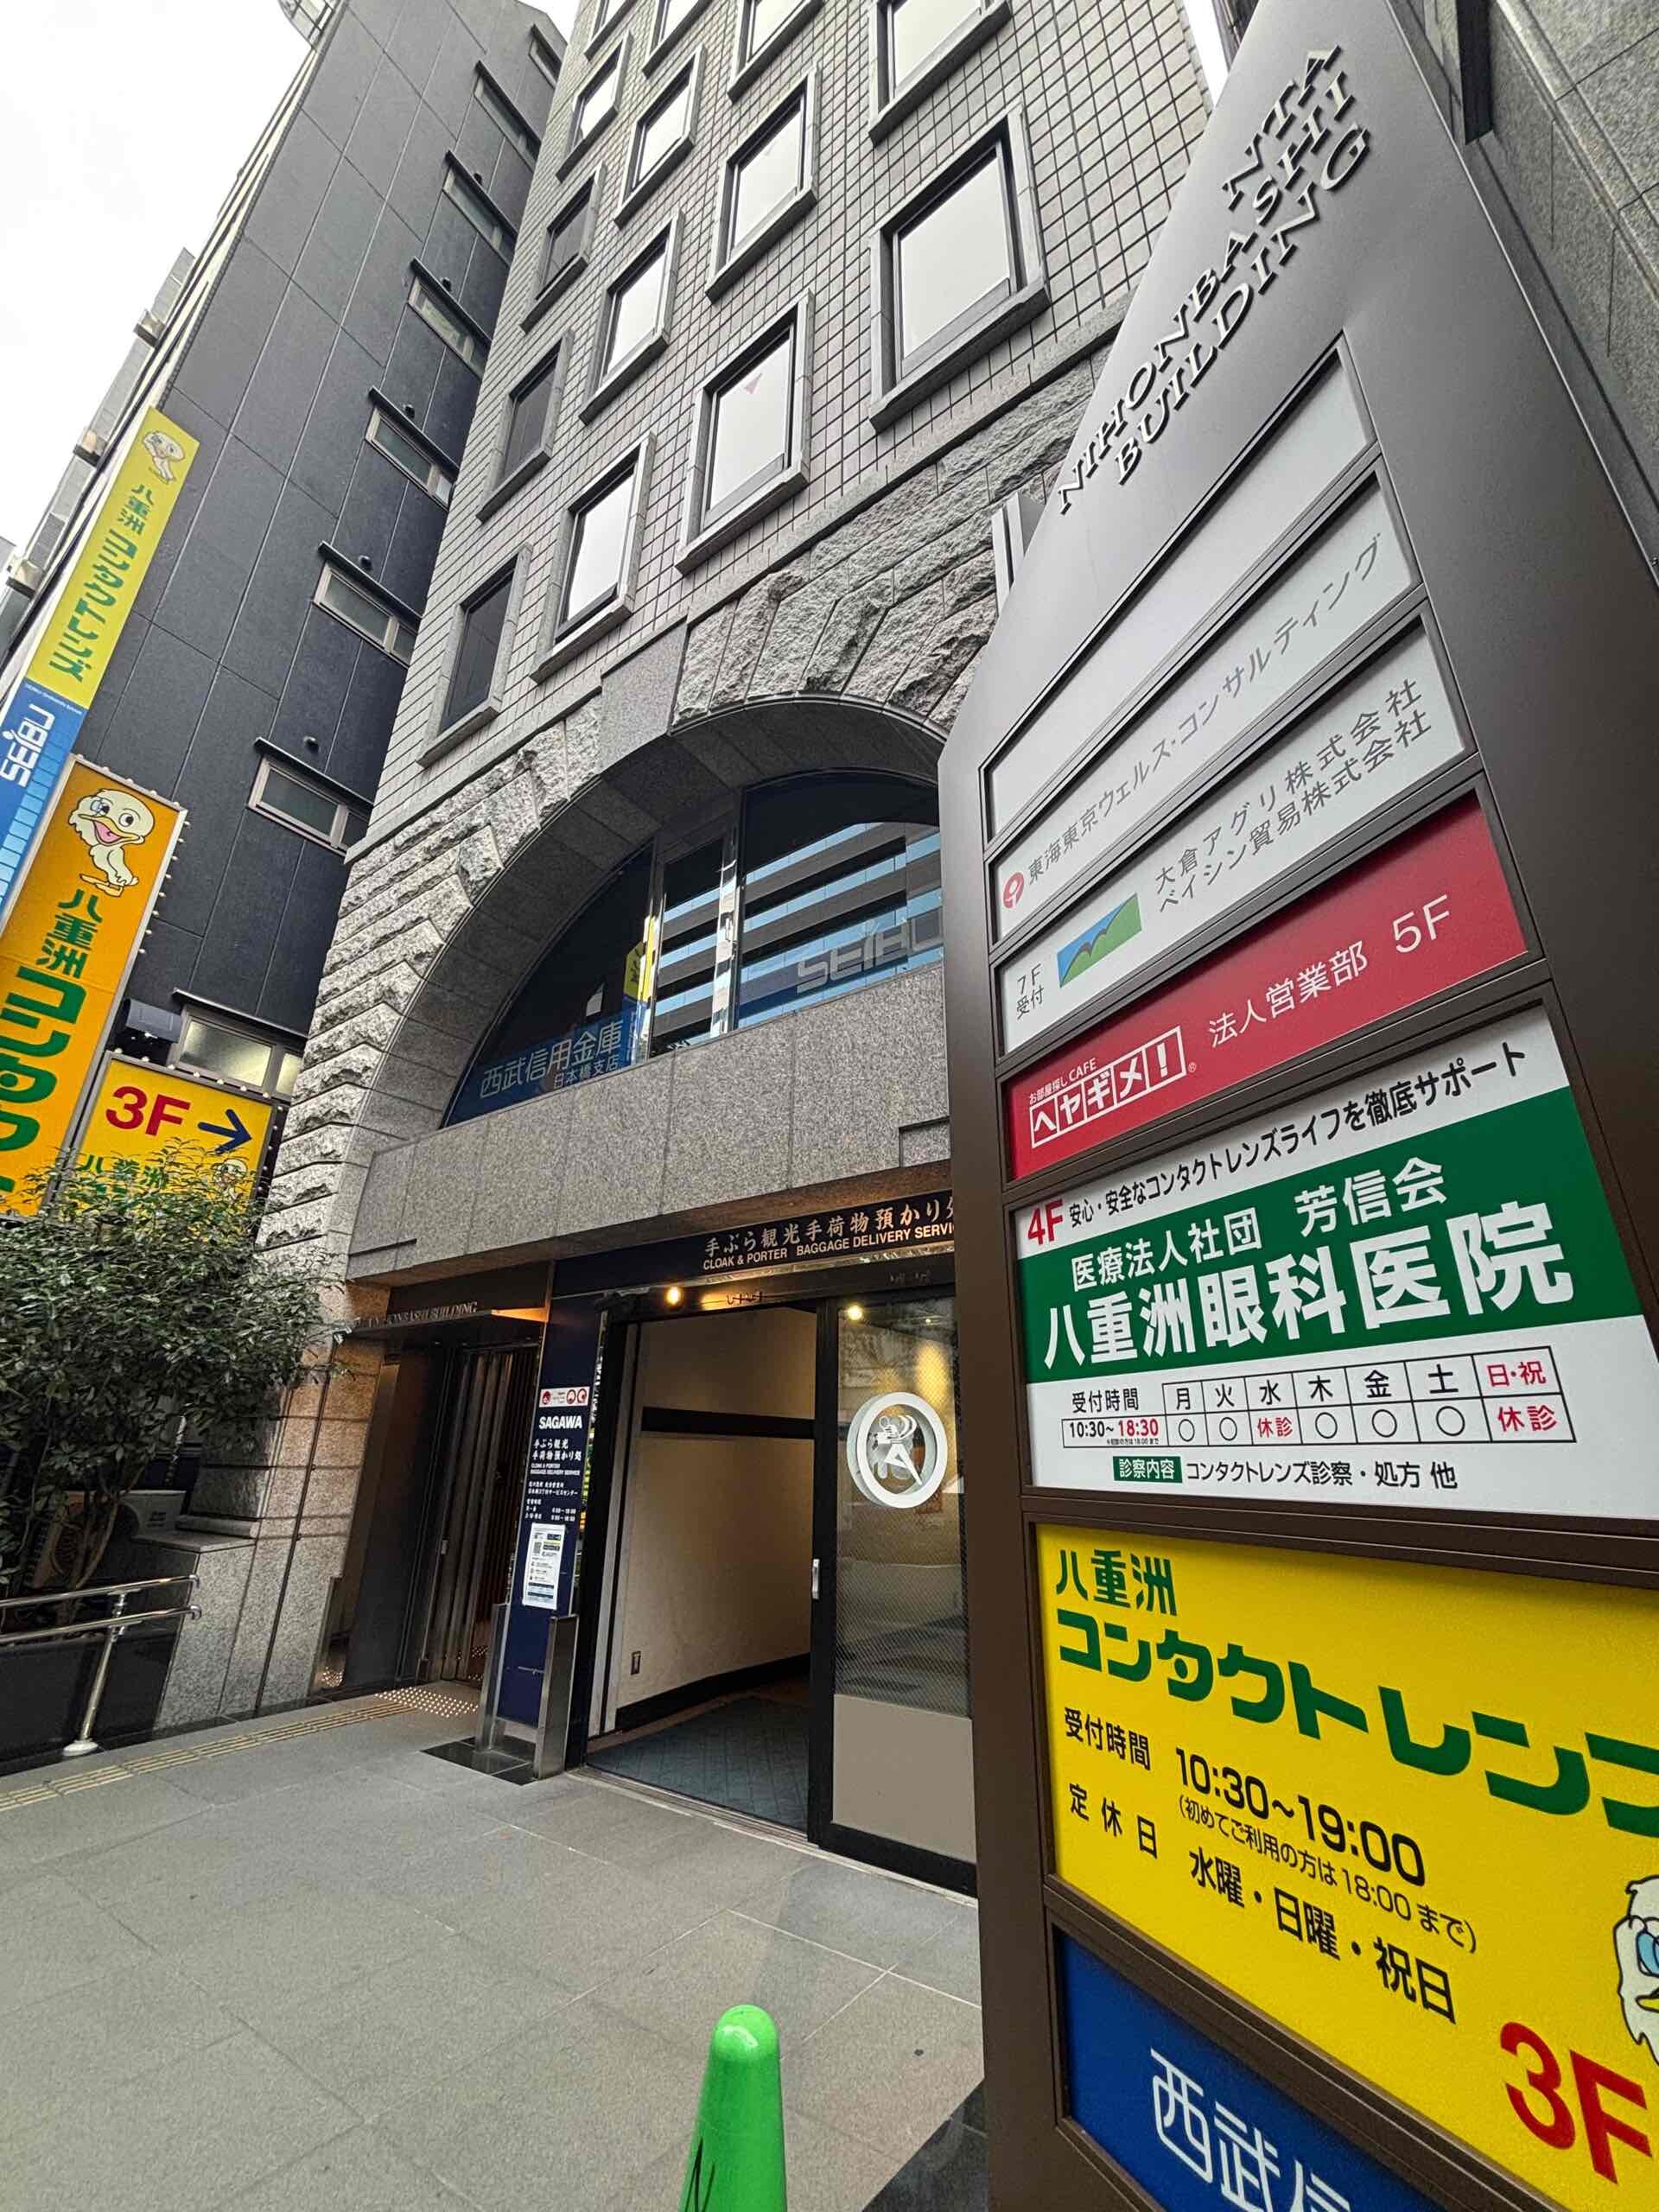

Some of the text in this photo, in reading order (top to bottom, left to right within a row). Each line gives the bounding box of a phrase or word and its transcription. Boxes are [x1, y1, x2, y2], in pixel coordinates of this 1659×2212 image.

[1058, 71, 1356, 515] NIHONBASHI
[1115, 122, 1370, 485] BUILDING
[117, 483, 154, 535] 八重洲
[49, 530, 137, 683] コンタクトレンズ
[0, 703, 55, 787] SEIBU
[1028, 532, 1382, 885] 東海東京ウェルス・コンサルティング
[1155, 678, 1423, 893] 大倉アグリ株式会社
[1160, 710, 1432, 912] ベイシン貿易株式会社
[1017, 963, 1041, 994] 7F
[1017, 985, 1044, 1020] 受付
[1209, 894, 1452, 1047] 法人営業部 5F
[0, 889, 104, 1193] 八重洲 コンタク
[480, 1020, 624, 1098] 西武信用金庫
[1069, 1057, 1096, 1081] CAFE
[105, 1085, 191, 1136] 3F
[1027, 1042, 1526, 1245] 4F 安心・安全なコンタクトレンズライフを徹底サポート
[703, 1224, 954, 1270] CLOAK & PORTER BAGGAGE DELIVERY SERVI
[1071, 1157, 1446, 1292] 医療法人社団 芳信会
[1044, 1202, 1573, 1370] 八重洲眼科医院
[539, 1416, 582, 1429] SAGAWA
[1072, 1360, 1547, 1414] 受付時間 月 火 水 木 金 土 日・祝
[1118, 1419, 1159, 1436] 18:30
[1257, 1416, 1294, 1439] 休診
[1497, 1403, 1557, 1433] 休診
[1119, 1459, 1458, 1490] 診察内容 コンタクトレンズ診察・処方 他
[1056, 1548, 1178, 1617] 八重洲
[1065, 1707, 1151, 1771] 受付時間
[1189, 1846, 1457, 2025] 水曜・日曜・祝日
[1500, 2021, 1653, 2184] 3F
